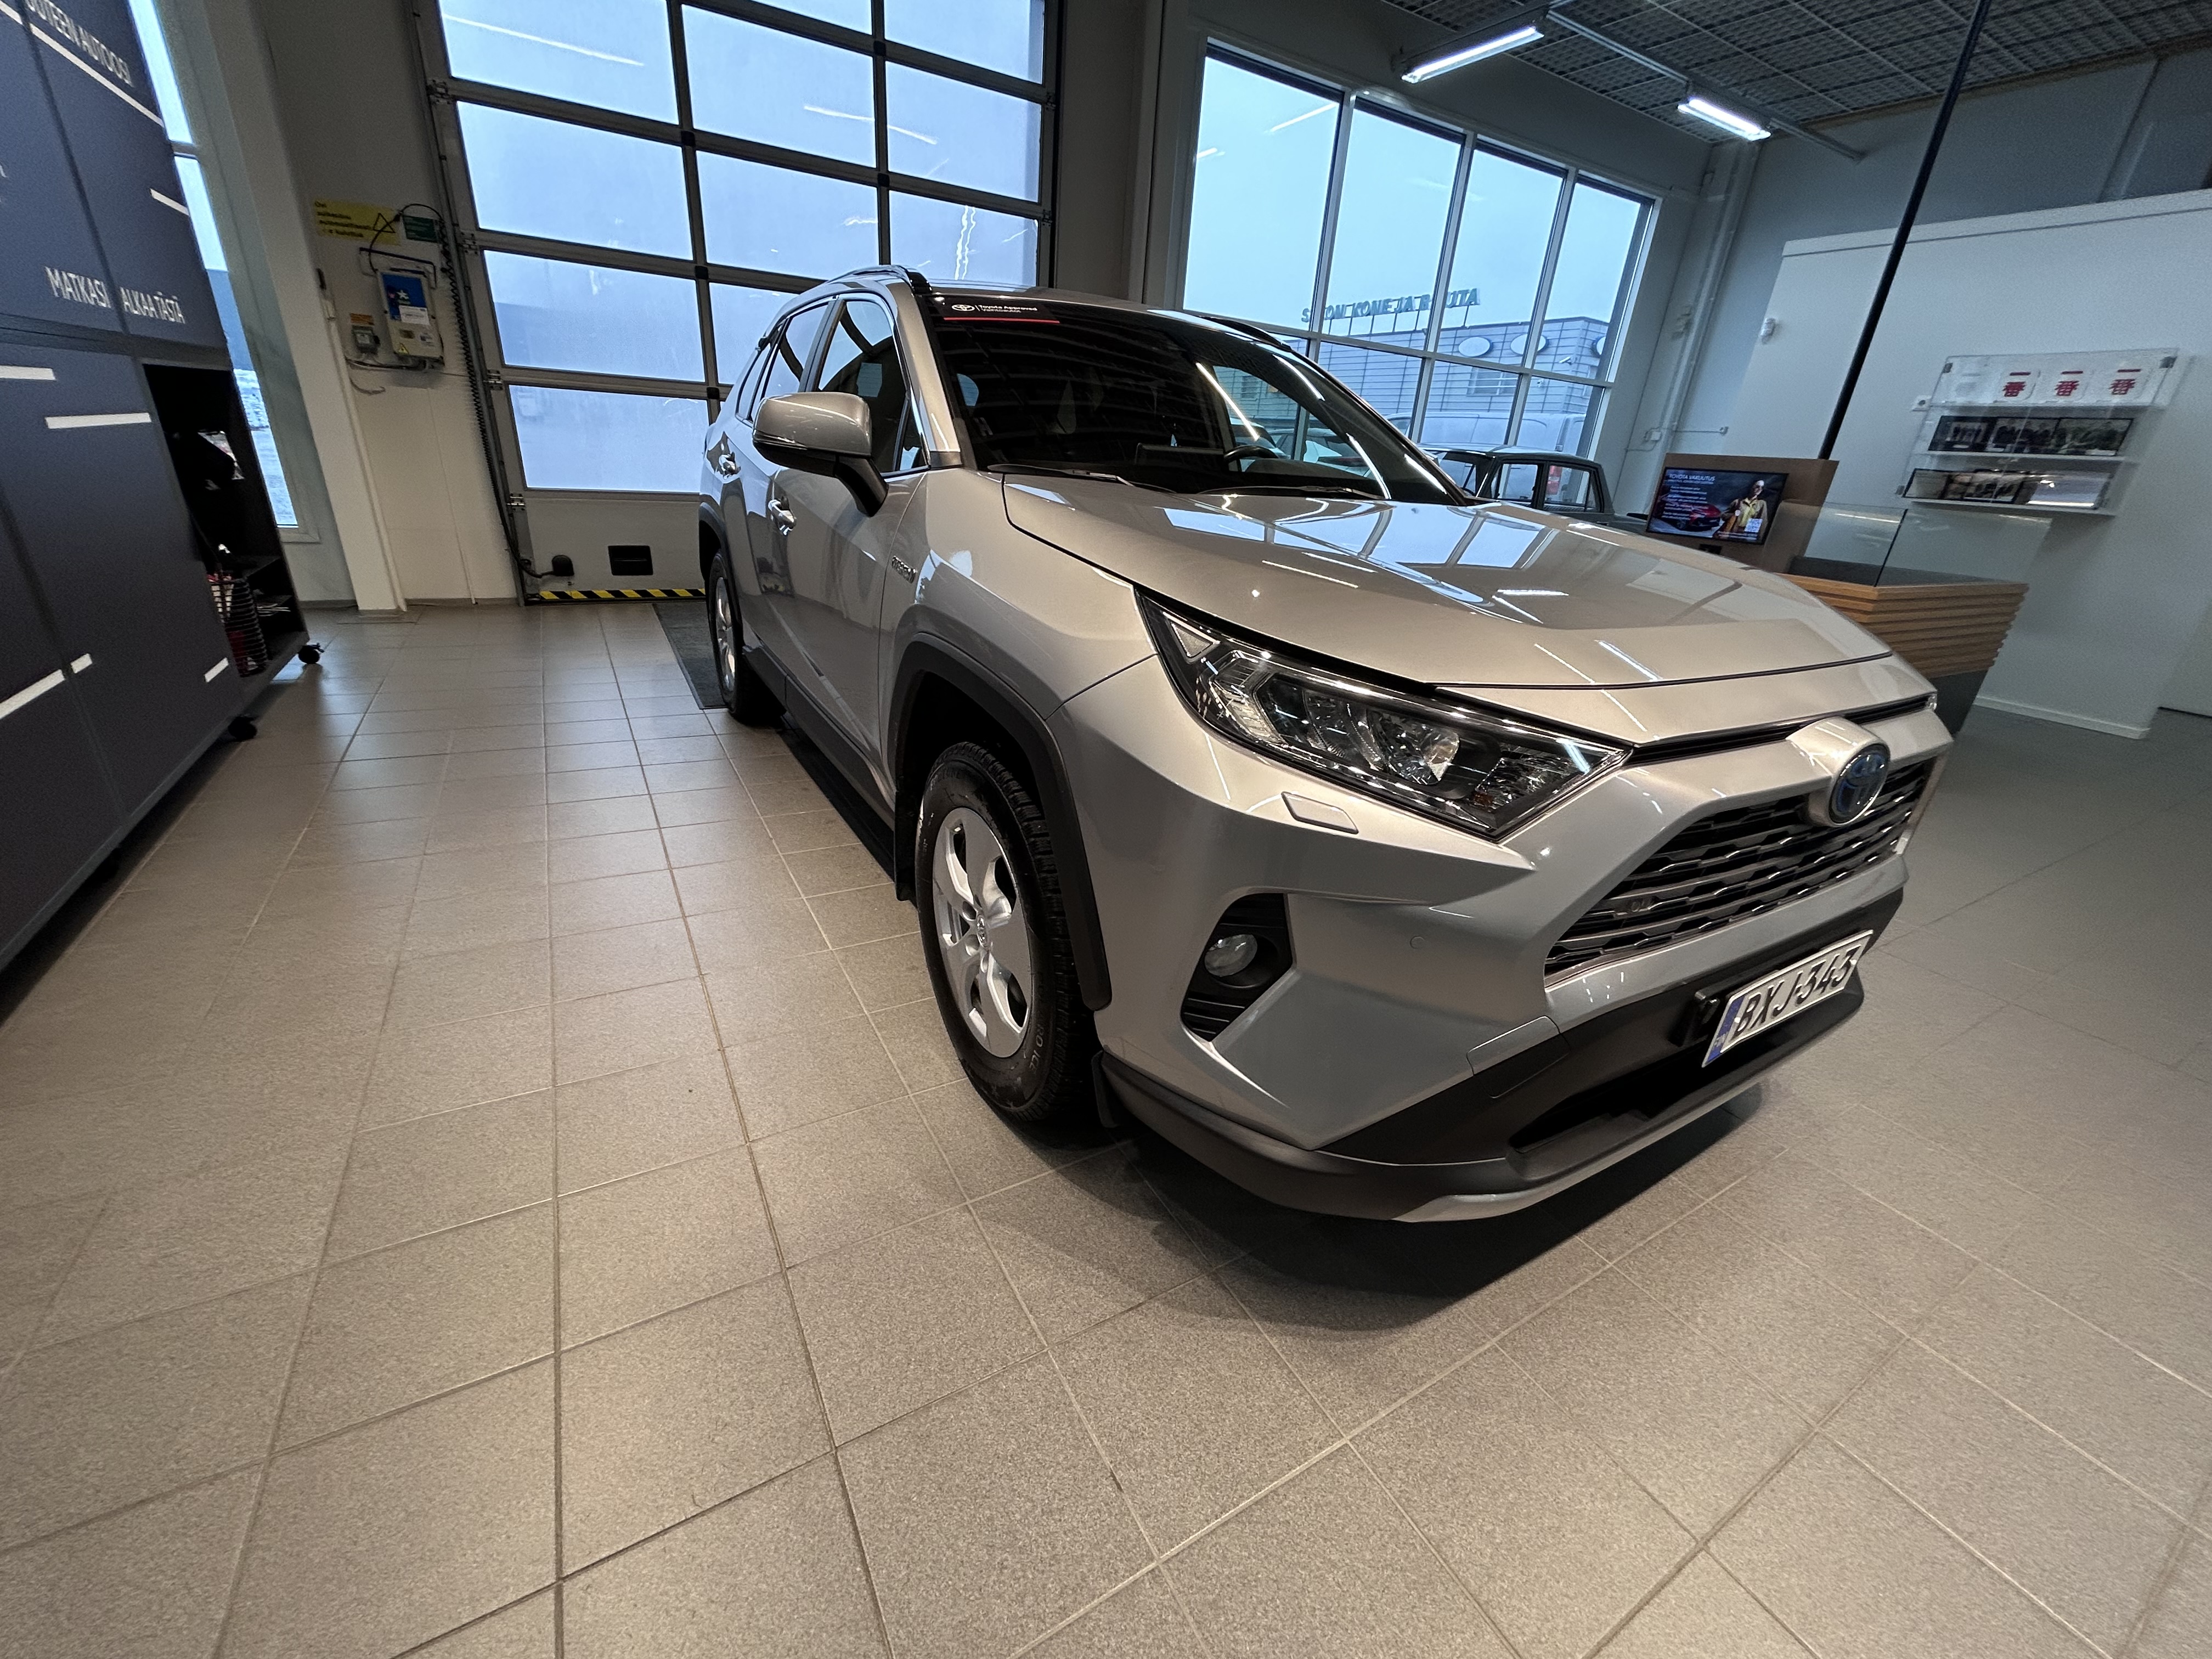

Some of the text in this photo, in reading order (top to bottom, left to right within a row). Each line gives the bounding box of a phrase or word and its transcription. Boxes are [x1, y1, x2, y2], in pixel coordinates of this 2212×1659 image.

[45, 266, 185, 324] MATKASI ALKAA TÄSTÄ
[1419, 288, 1480, 311] RUTA
[1732, 944, 1861, 1039] BXJ-343
